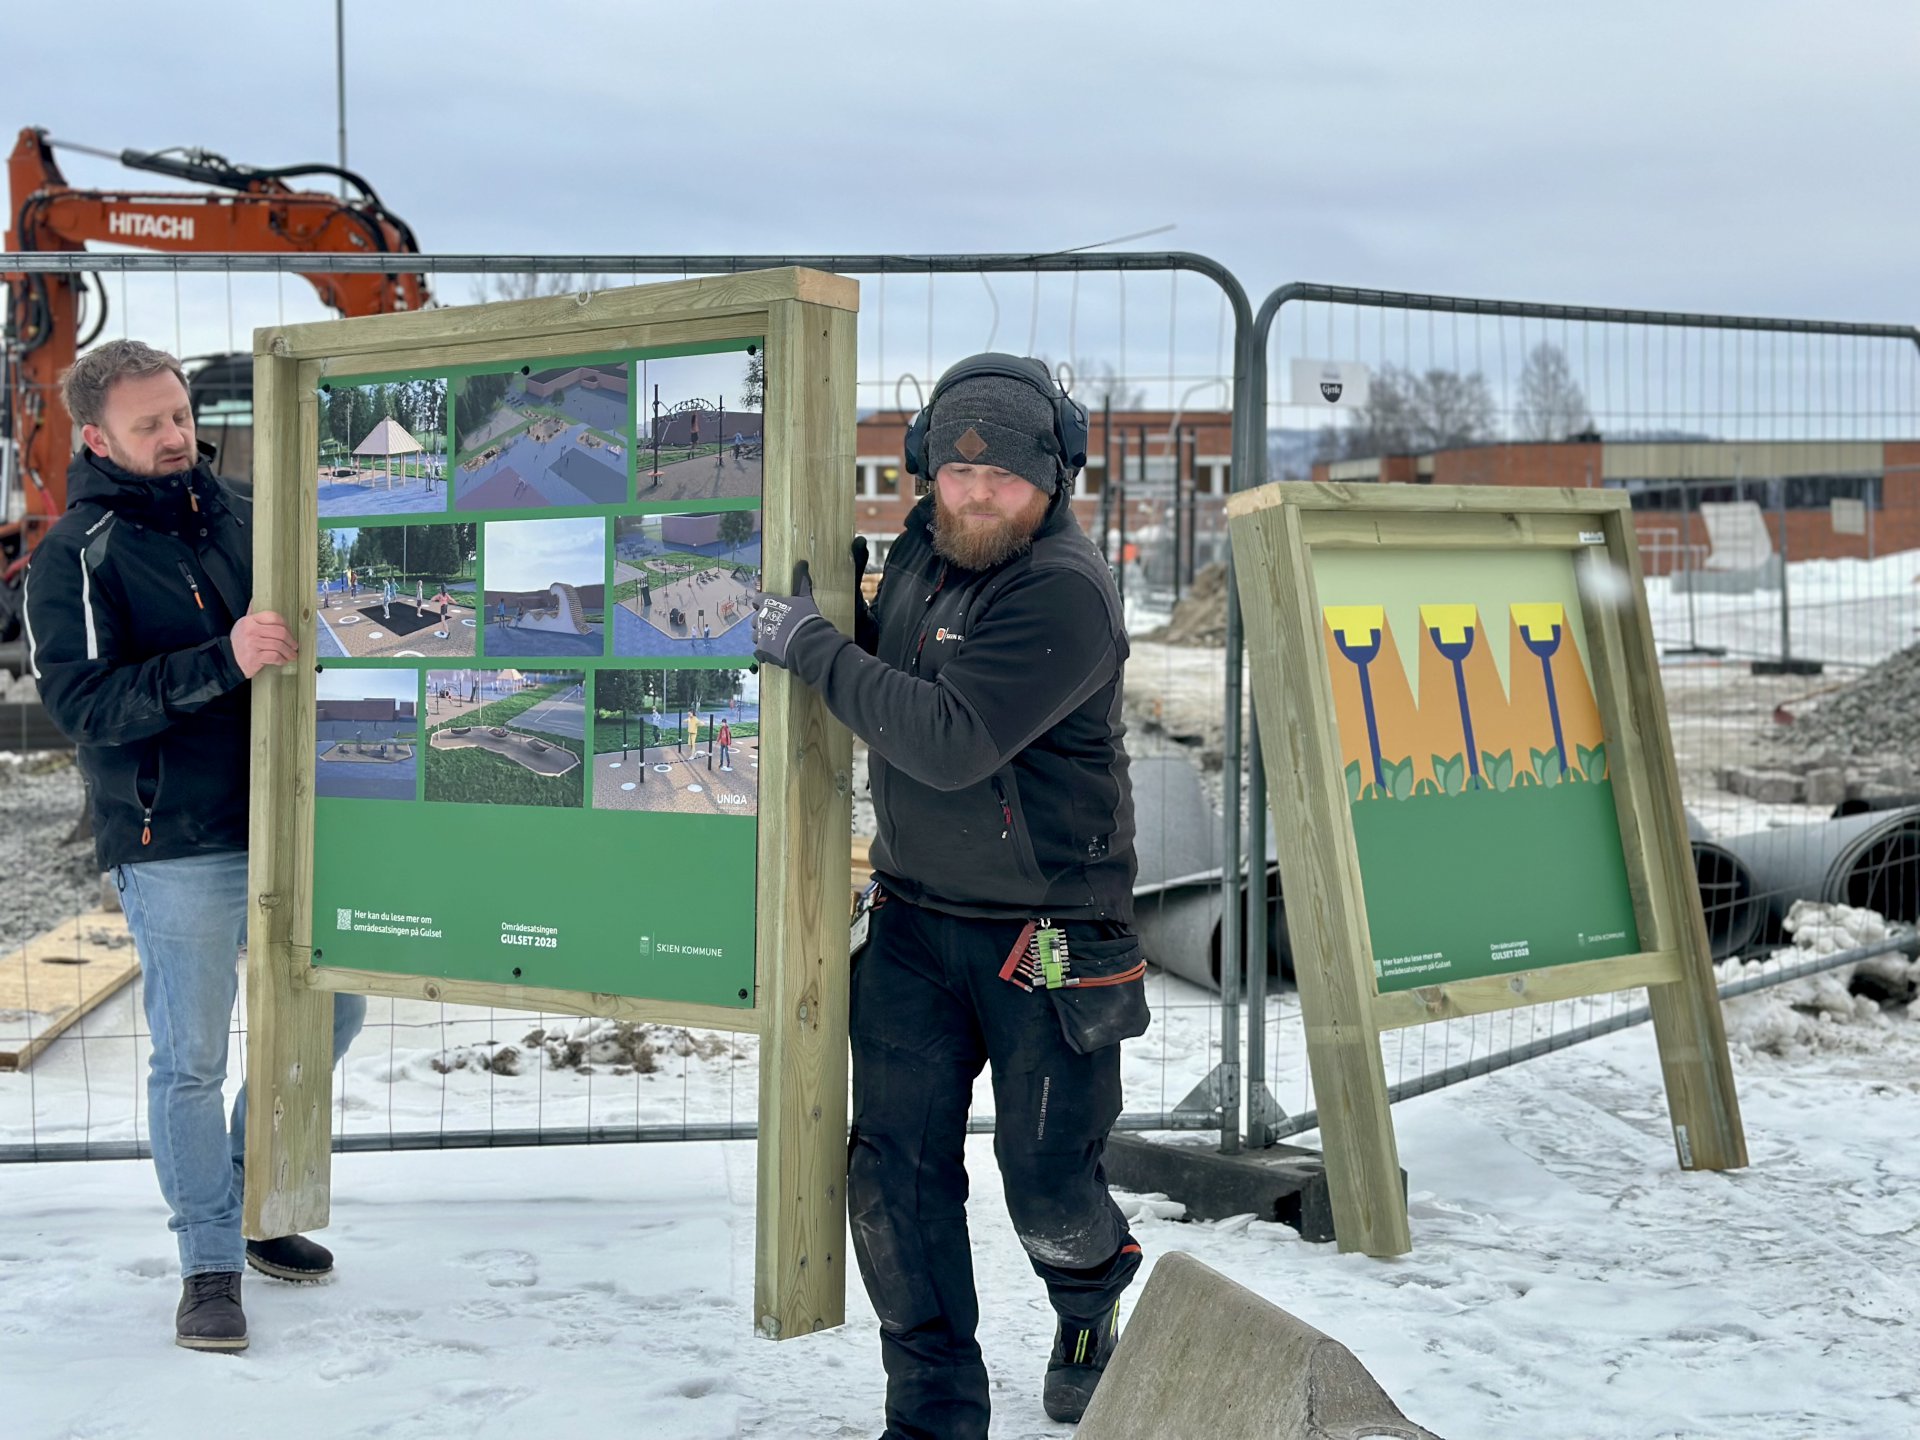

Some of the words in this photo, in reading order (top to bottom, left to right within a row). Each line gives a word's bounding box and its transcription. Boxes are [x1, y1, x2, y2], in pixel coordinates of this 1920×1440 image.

[109, 211, 194, 240] HITACHI
[717, 794, 747, 805] UNIQA
[354, 909, 367, 919] Her
[367, 910, 380, 920] kan
[380, 912, 390, 921] du
[390, 913, 405, 922] lese
[405, 914, 420, 924] mer
[420, 916, 432, 924] om
[353, 923, 410, 937] områdesatsingen
[410, 926, 419, 937] på
[420, 927, 442, 938] Gulset
[501, 921, 558, 936] Områdesatsingen
[500, 933, 534, 946] GULSET
[534, 936, 557, 948] 2028
[656, 943, 680, 953] SKIEN
[681, 945, 723, 957] KOMMUNE
[1491, 950, 1513, 961] GULSET
[1513, 947, 1529, 958] 2028
[1383, 957, 1393, 966] Her
